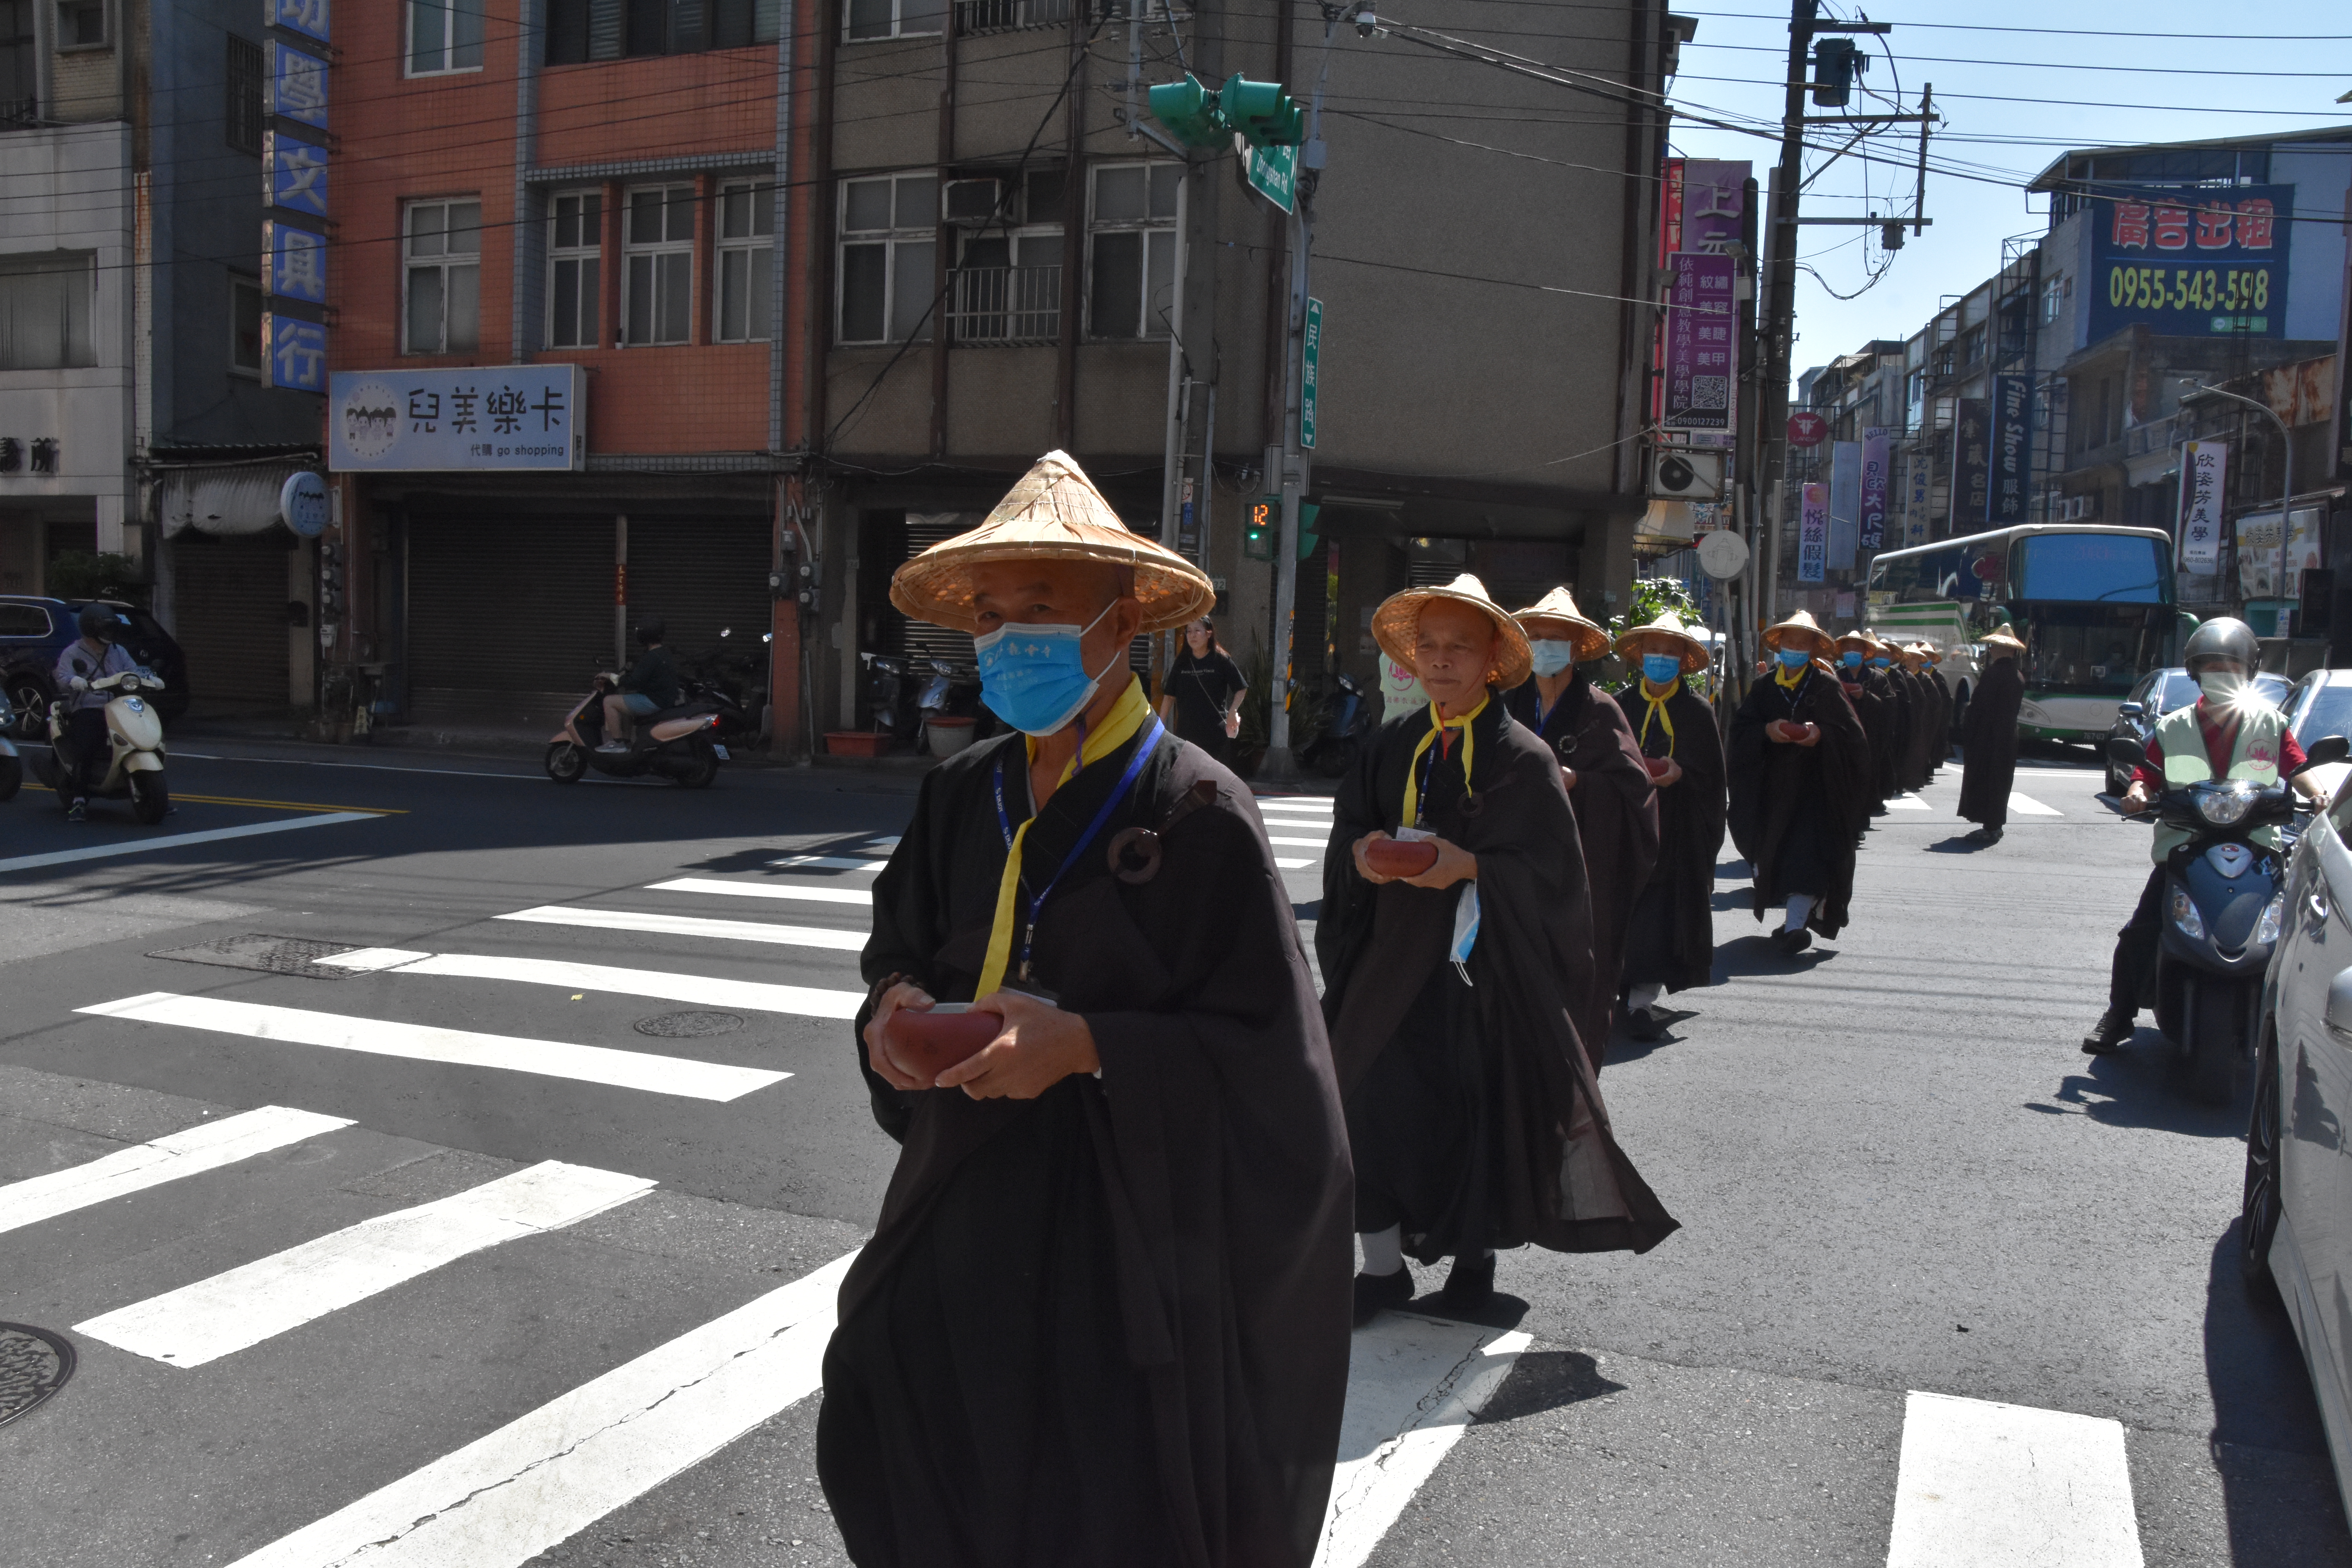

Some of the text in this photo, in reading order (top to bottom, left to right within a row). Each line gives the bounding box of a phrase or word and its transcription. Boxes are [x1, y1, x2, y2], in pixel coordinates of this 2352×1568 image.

[1257, 154, 1281, 189] Zhongshan
[2112, 196, 2273, 250] 廣告出租
[2110, 266, 2269, 311] 0955-543-598
[1699, 301, 1728, 315] 美容
[1305, 324, 1318, 428] 民族路
[1697, 352, 1725, 366] 美甲
[409, 385, 564, 434] 兒美樂卡
[1677, 417, 1724, 425] 0900127239
[2003, 379, 2027, 473] Fine Show
[497, 446, 510, 456] go
[515, 445, 564, 457] shopping
[1865, 428, 1888, 441] BELLO
[1254, 505, 1268, 525] 12
[2002, 479, 2021, 516] 服飾
[2191, 454, 2215, 541] 欣姿芳美學
[1803, 509, 1823, 579] 悅絲假髮
